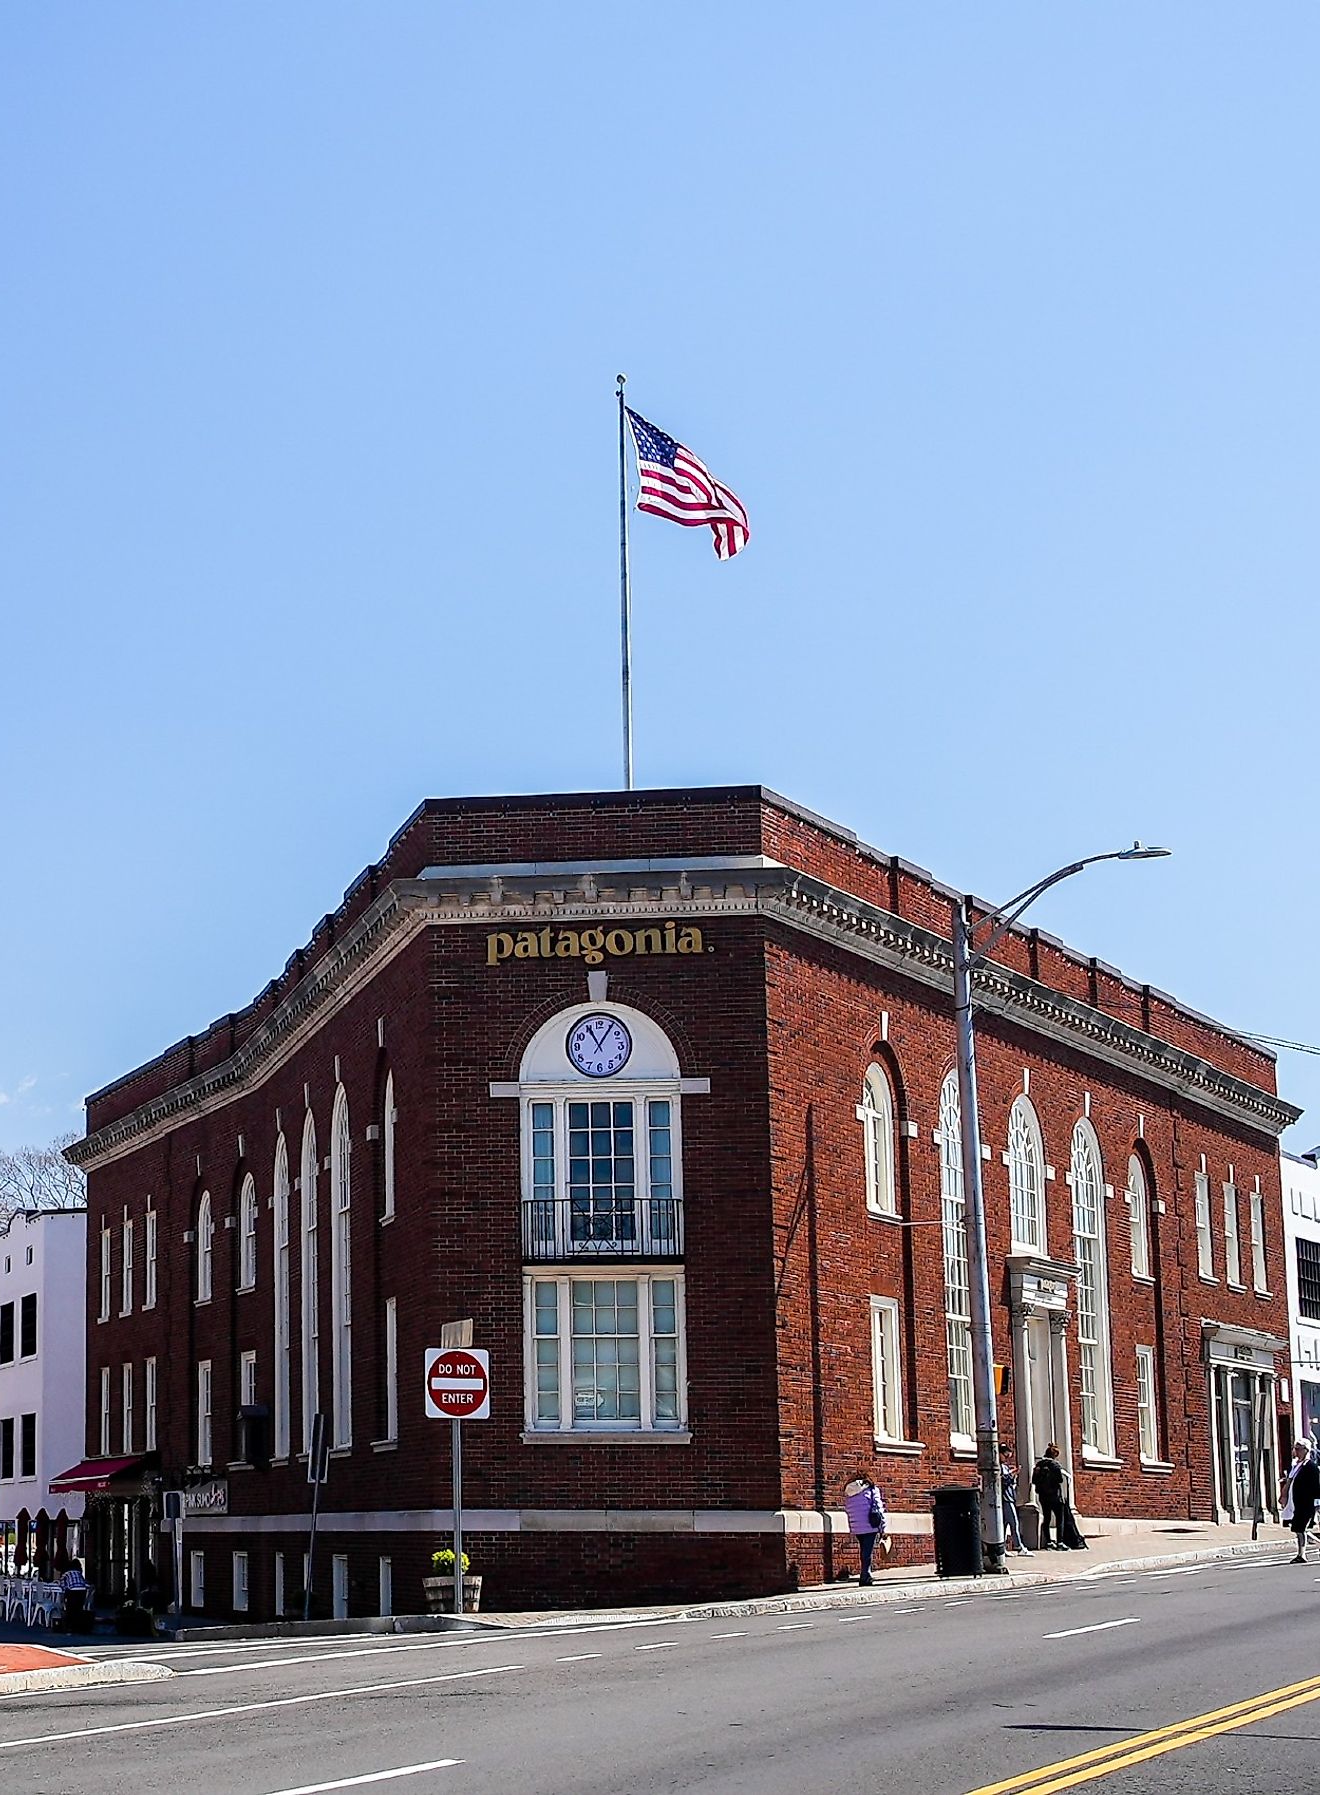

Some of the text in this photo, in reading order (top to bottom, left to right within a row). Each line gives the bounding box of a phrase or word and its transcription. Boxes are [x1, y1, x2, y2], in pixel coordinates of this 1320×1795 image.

[485, 921, 704, 966] patagonia
[595, 1020, 604, 1029] 12
[576, 1032, 585, 1041] 10
[613, 1030, 621, 1040] 2
[573, 1042, 581, 1051] 9
[617, 1042, 625, 1051] 3
[577, 1053, 585, 1062] 8
[614, 1053, 622, 1061] 4
[586, 1061, 593, 1070] 7
[596, 1063, 603, 1072] 6
[607, 1060, 614, 1069] 5
[438, 1363, 476, 1375] DO NOT
[441, 1392, 474, 1404] ENTER
